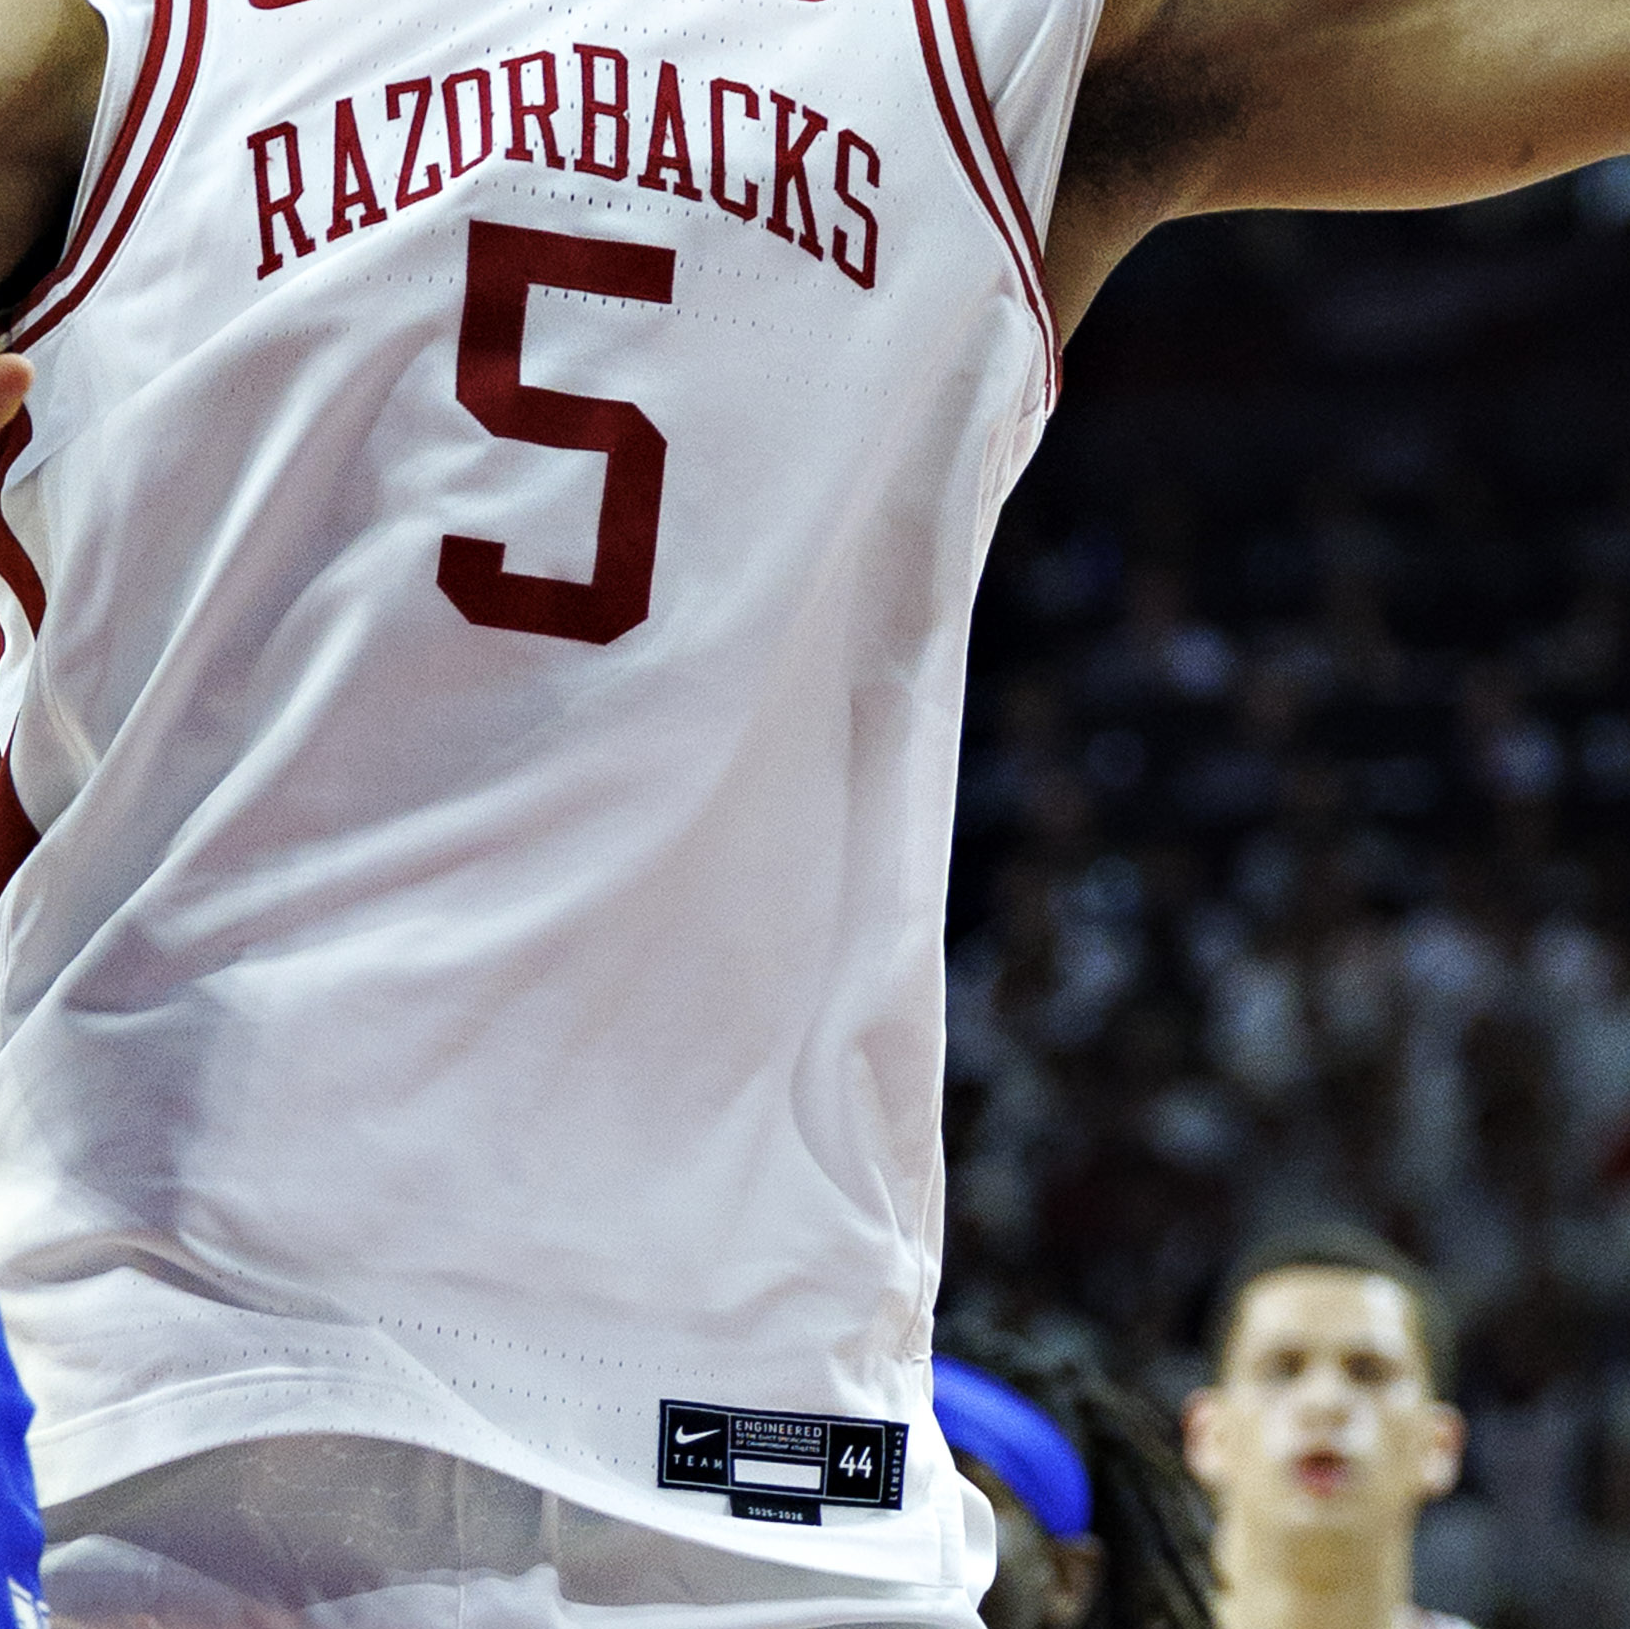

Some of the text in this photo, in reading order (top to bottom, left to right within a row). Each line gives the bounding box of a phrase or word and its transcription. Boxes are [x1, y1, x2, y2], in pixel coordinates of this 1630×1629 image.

[246, 42, 881, 290] RAZORBACKS
[436, 219, 676, 645] 5
[735, 1420, 823, 1438] ENGINEERED
[673, 1453, 723, 1470] TEAM
[839, 1444, 873, 1478] 44
